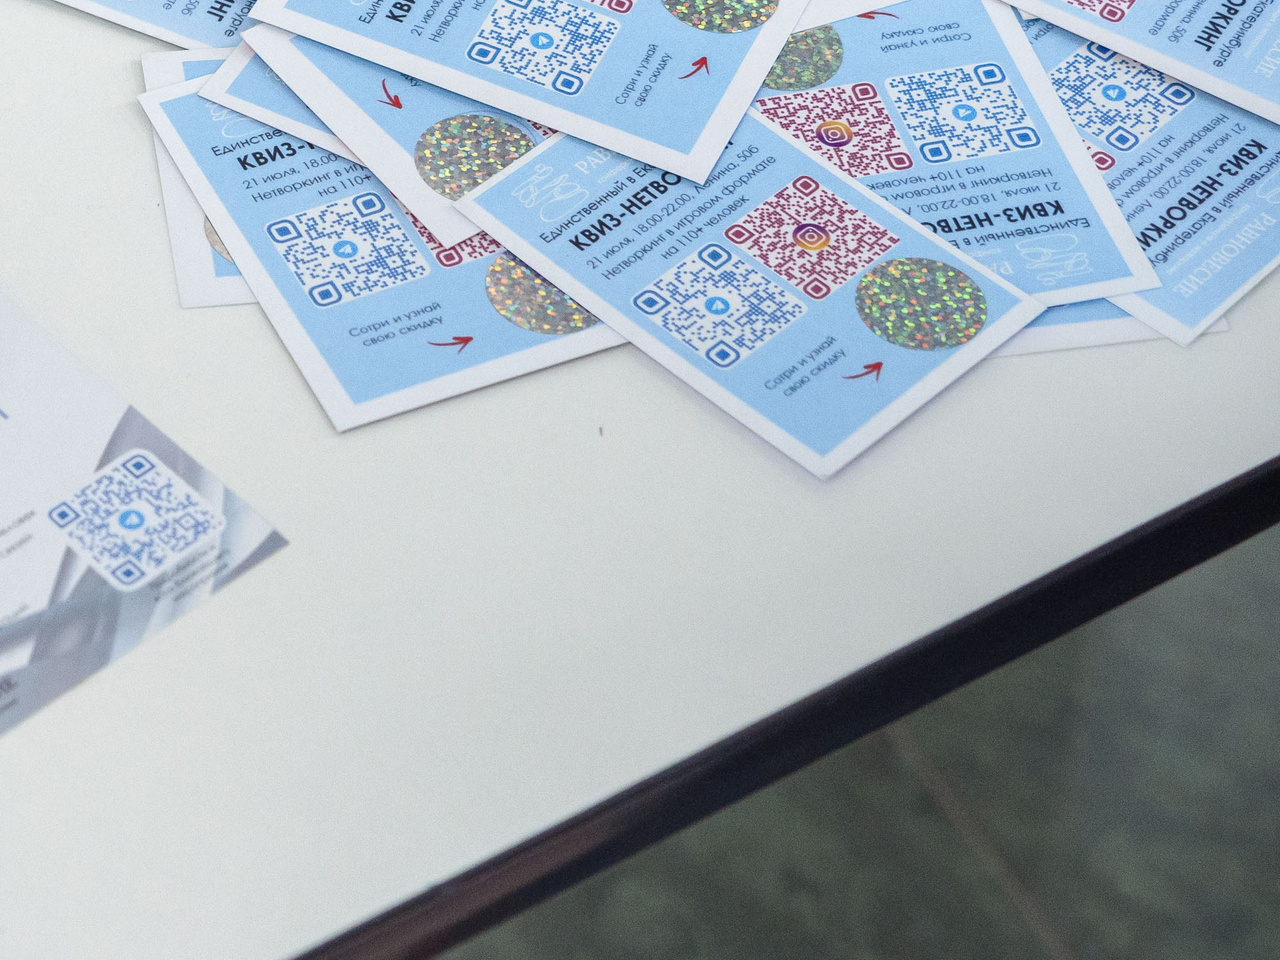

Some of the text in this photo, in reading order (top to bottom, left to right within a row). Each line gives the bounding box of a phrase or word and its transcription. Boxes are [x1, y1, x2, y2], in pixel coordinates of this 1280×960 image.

[409, 23, 425, 37] 21
[879, 32, 972, 54] Сотри узнай
[880, 22, 960, 41] свою скидку
[1030, 21, 1059, 42] отри
[613, 43, 659, 105] Сотри и узнай
[633, 51, 673, 107] свою скидку
[209, 127, 288, 157] Единстве
[1121, 112, 1231, 199] Нетворкинг игровом
[241, 167, 301, 190] 21 июля,
[928, 169, 963, 182] 110+
[964, 164, 986, 175] на
[1106, 133, 1176, 191] на 110+ челов
[1123, 122, 1247, 223] 21 июля, 18.00-22.00, Лени
[250, 168, 343, 203] Нетворкинг в
[317, 173, 373, 197] на 110+
[890, 167, 1054, 201] Нетворкинг игровом
[916, 181, 1062, 214] 21 июля, 18.00-22.00,
[1130, 138, 1269, 251] КВИЗ-НЕТВОРКИ
[538, 175, 637, 244] Единственный в
[600, 154, 777, 280] Нетворкинг в игровом формате
[660, 194, 751, 260] на 110+ человек
[920, 199, 1066, 238] КВИЗ-НЕТВ
[1147, 154, 1280, 269] инственный Екатеринбу
[585, 255, 603, 269] 21
[601, 236, 635, 259] июля,
[631, 192, 695, 236] 18.00-22.00,
[973, 217, 1091, 247] Единственный
[1169, 211, 1279, 300] РАВНОВЕСИЕ
[348, 301, 442, 337] Сотри и узнай
[361, 315, 442, 347] свою скидку
[763, 336, 837, 390] Сотри и узнай
[782, 349, 846, 397] свою скидку
